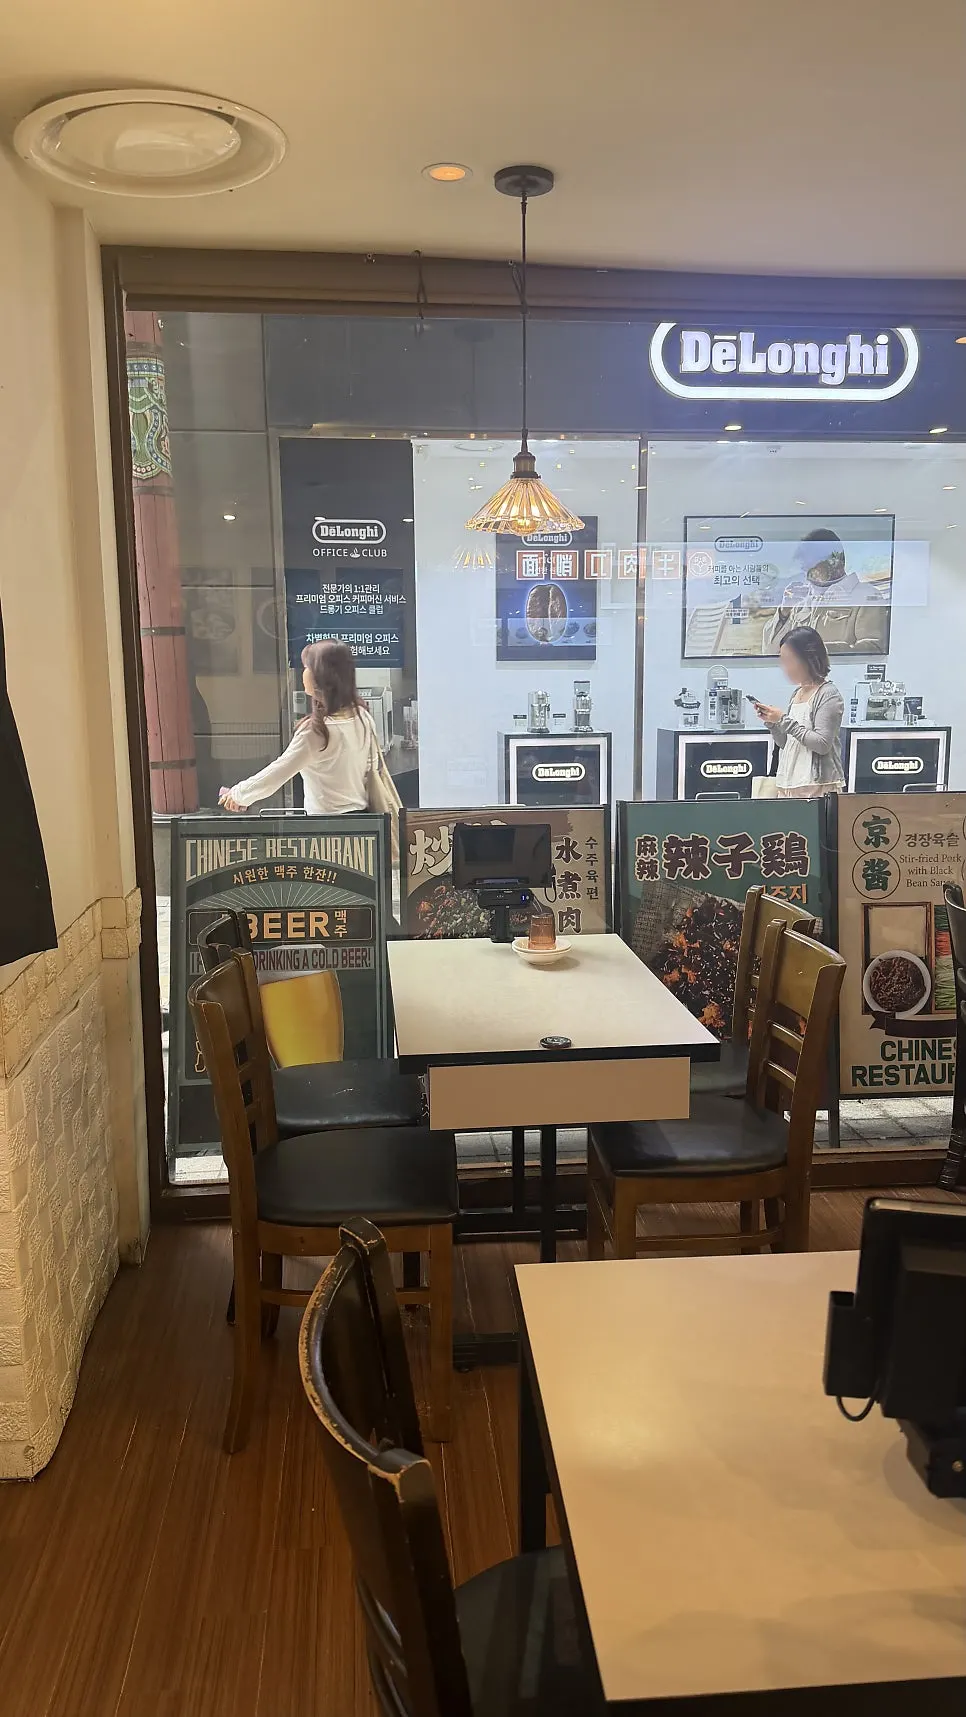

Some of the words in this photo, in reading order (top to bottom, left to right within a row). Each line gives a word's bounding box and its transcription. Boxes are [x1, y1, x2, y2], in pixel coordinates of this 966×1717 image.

[312, 548, 348, 557] OFFICE
[361, 548, 388, 557] CLUB
[713, 575, 740, 586] 최고의
[742, 575, 761, 586] 선택
[322, 583, 353, 594] 전문가의
[354, 583, 380, 594] 1:1관리
[295, 594, 327, 604] 프리미엄
[328, 594, 351, 604] 오피스
[352, 594, 382, 604] 커피머신
[384, 594, 407, 604] 서비스
[319, 604, 342, 615] 드롱기
[344, 604, 367, 615] 오피스
[368, 604, 384, 615] 클럽
[340, 633, 373, 643] 프리미엄
[374, 633, 399, 643] 오피스
[350, 645, 390, 656] 험해보세요
[905, 832, 960, 848] 경장육슬
[185, 838, 258, 881] CHINESE
[265, 836, 376, 877] RESTAURANT
[899, 853, 939, 863] Stir-fried
[941, 853, 962, 863] Pork
[233, 867, 269, 885] 시원한
[274, 865, 298, 879] 맥주
[303, 866, 337, 884] 한잔!!
[907, 866, 928, 875] with
[930, 866, 954, 875] Black
[906, 878, 928, 888] Bean
[302, 949, 309, 970] A
[311, 948, 339, 969] COLD
[341, 947, 371, 968] BEER!
[880, 1038, 957, 1062] CHINE
